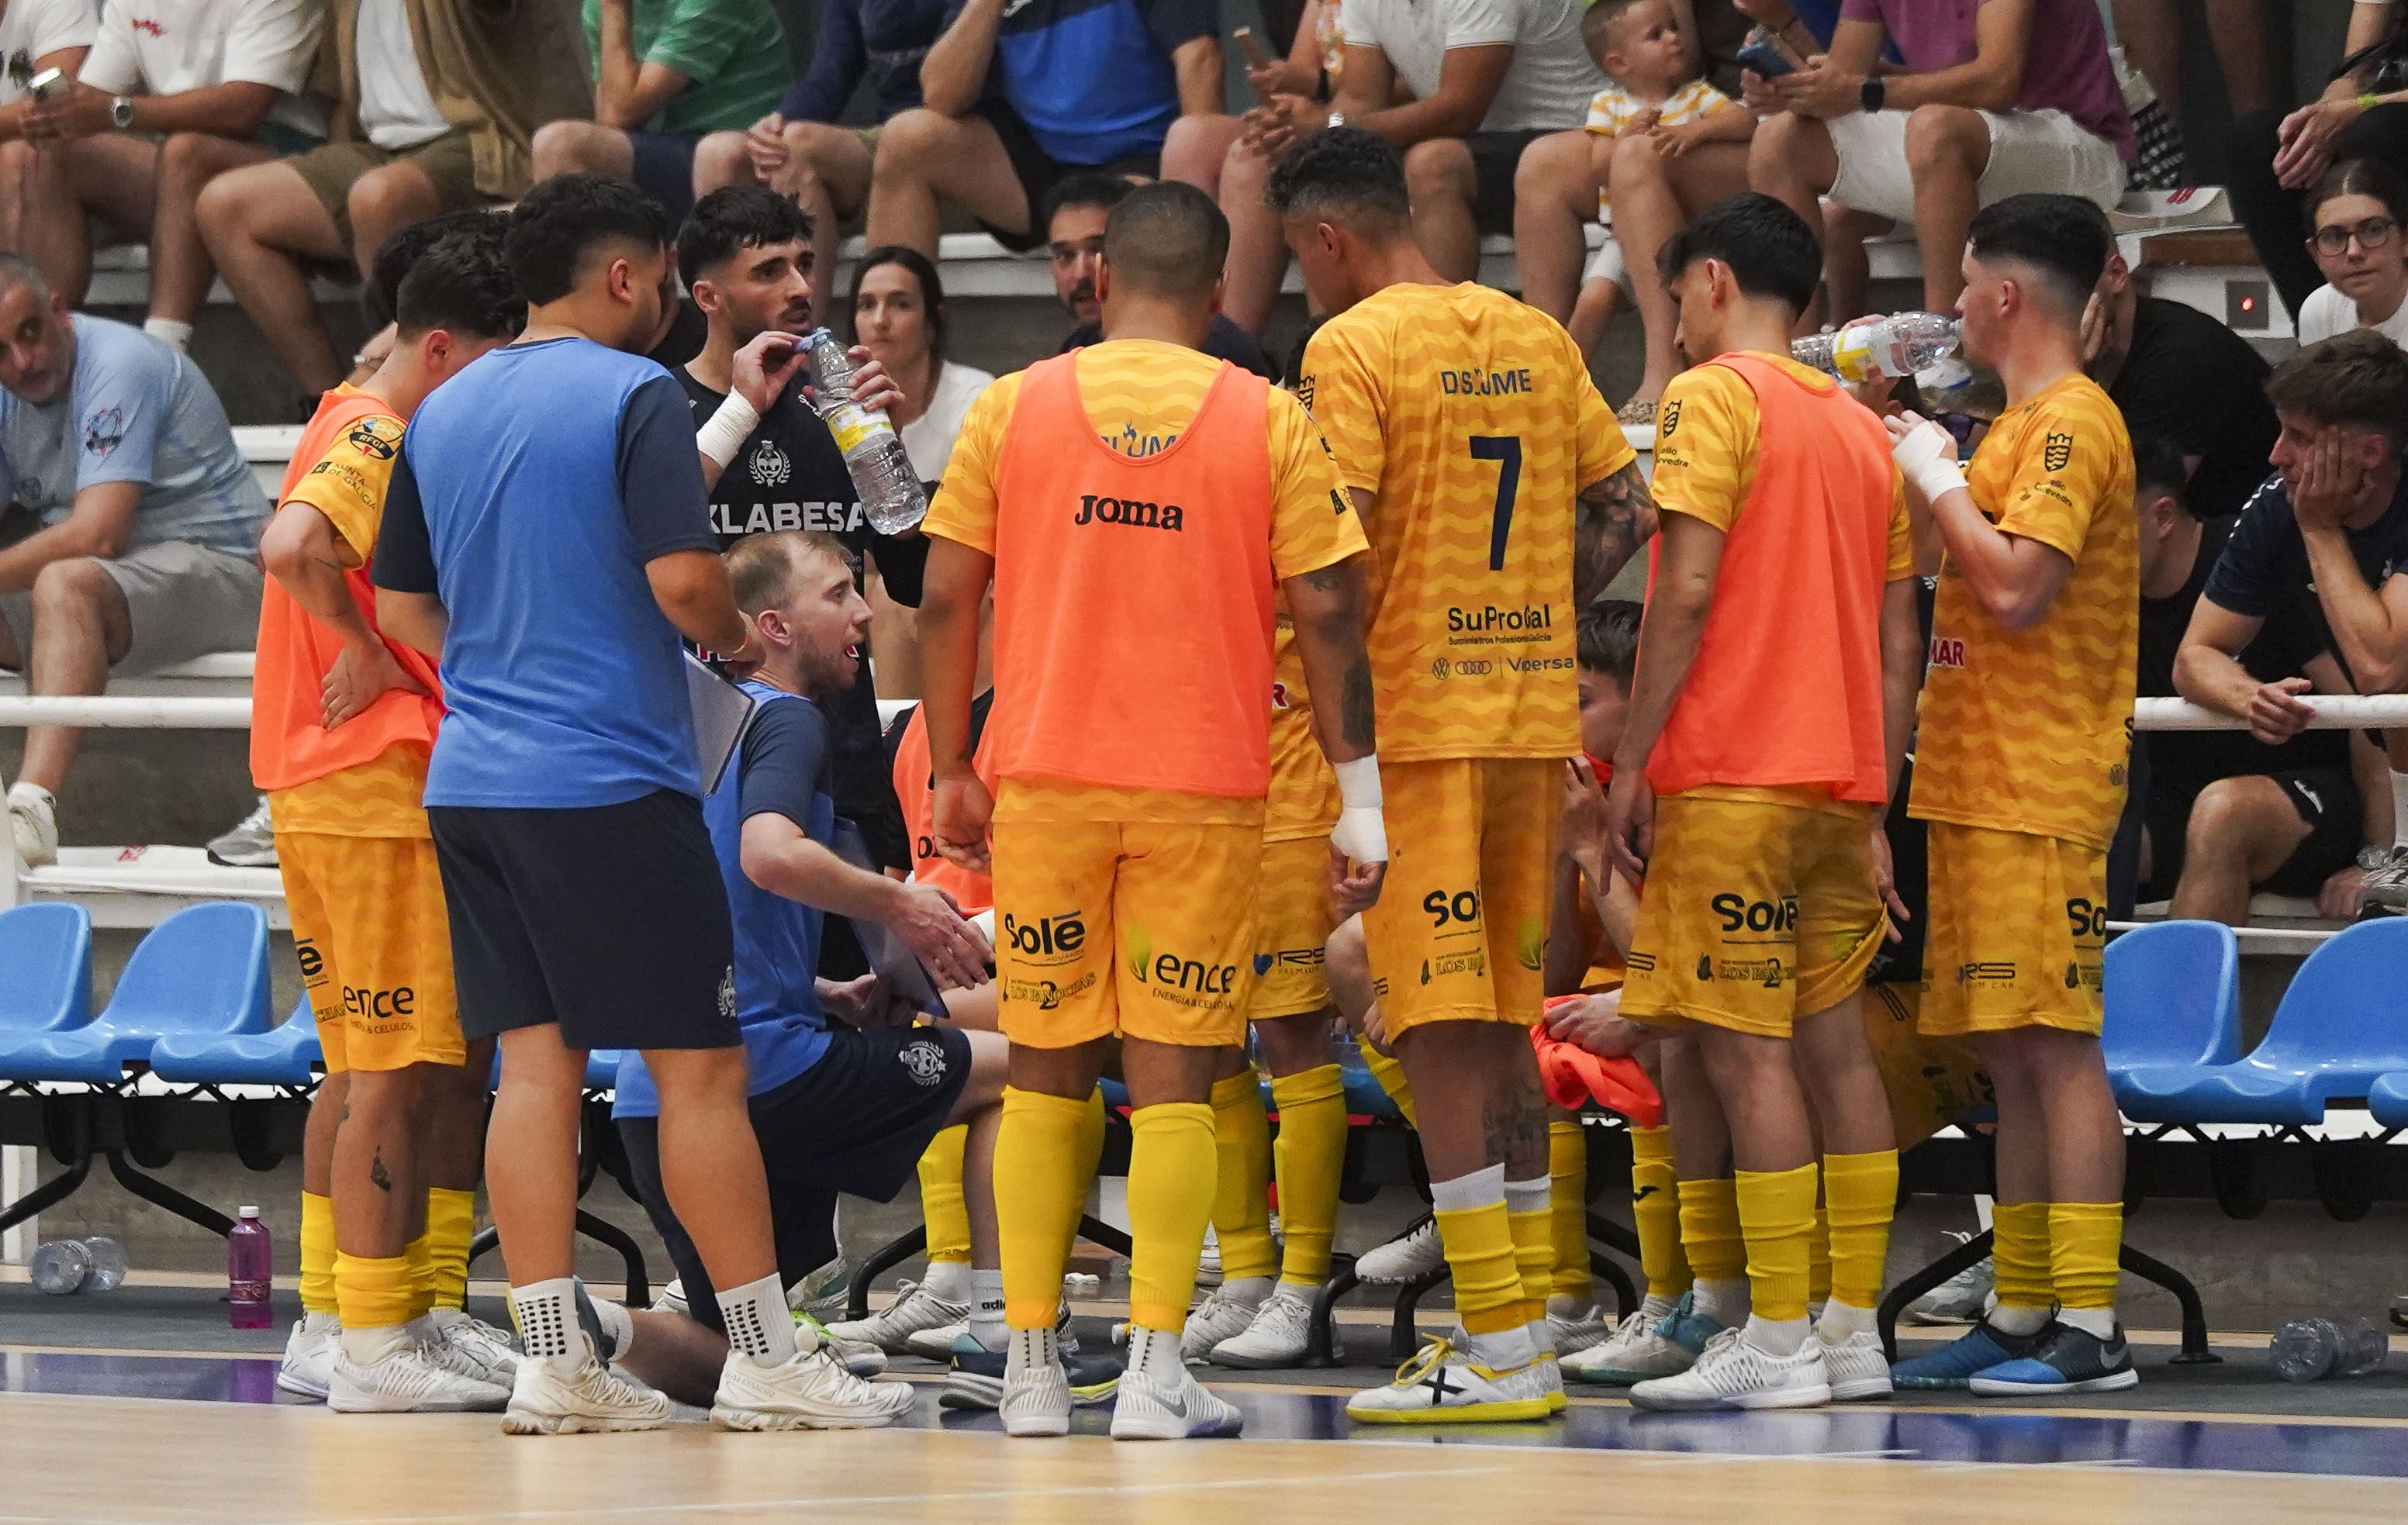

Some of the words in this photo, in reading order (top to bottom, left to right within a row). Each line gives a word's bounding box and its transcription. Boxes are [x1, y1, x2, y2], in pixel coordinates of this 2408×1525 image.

[1075, 495, 1183, 533] Joma
[1469, 436, 1522, 571] 7
[1155, 954, 1238, 994] ence
[343, 985, 415, 1019] ence
[375, 1022, 415, 1034] CELULOS
